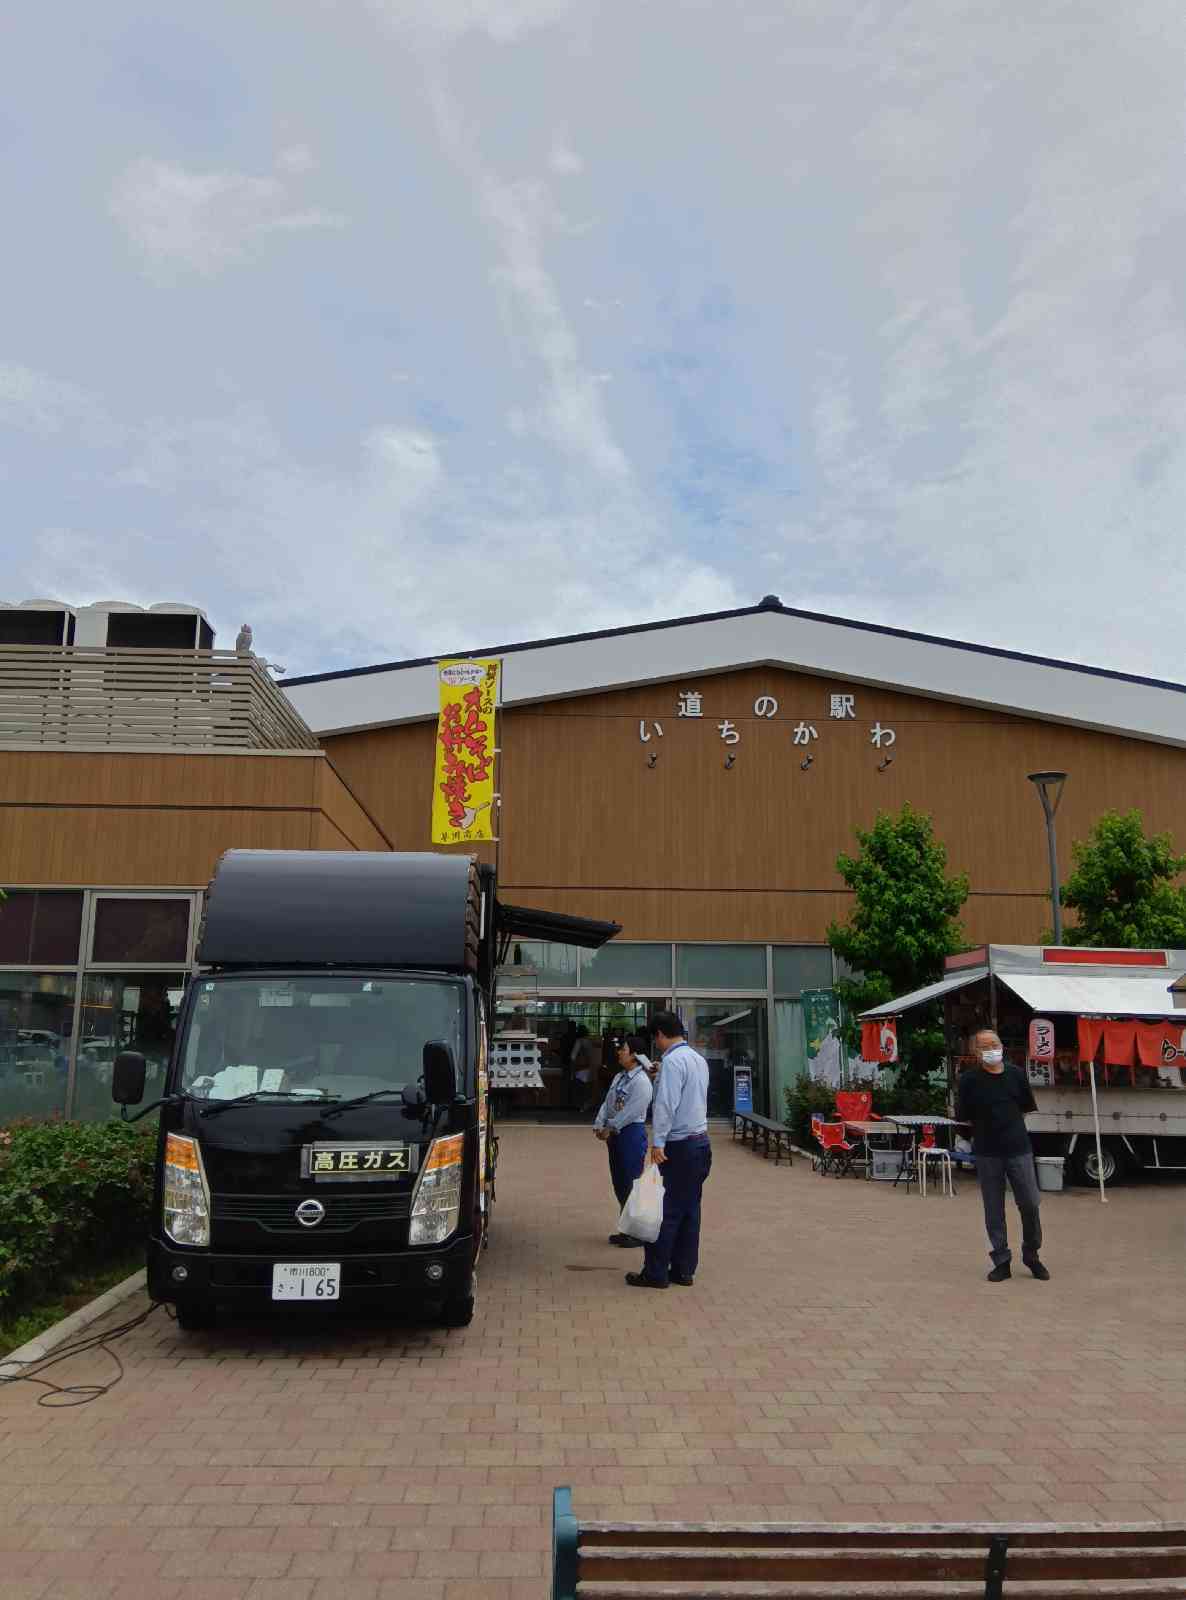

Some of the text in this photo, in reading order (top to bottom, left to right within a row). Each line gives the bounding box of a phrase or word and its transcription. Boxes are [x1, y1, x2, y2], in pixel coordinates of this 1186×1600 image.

[677, 691, 856, 719] 道の駅
[639, 719, 897, 748] いちかわ
[314, 1151, 406, 1170] 高圧ガス
